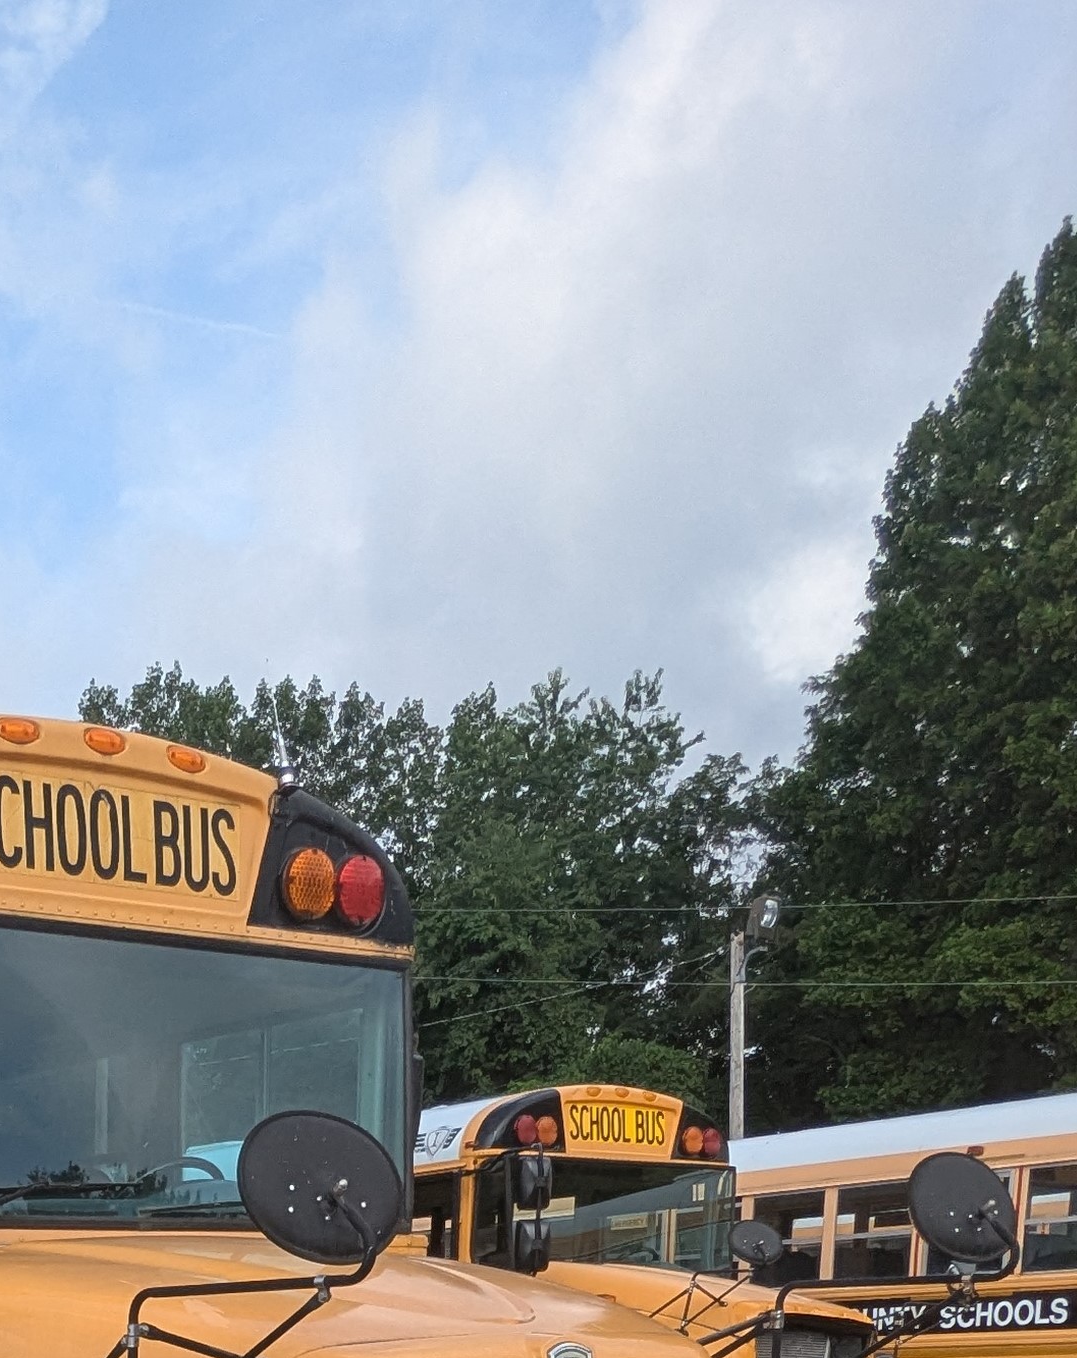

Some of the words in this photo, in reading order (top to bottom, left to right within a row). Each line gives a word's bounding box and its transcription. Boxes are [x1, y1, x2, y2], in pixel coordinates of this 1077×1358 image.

[153, 800, 237, 896] BUS
[569, 1105, 630, 1144] SCHOOL
[635, 1110, 665, 1146] BUS
[939, 1298, 1069, 1329] SCHOOLS
